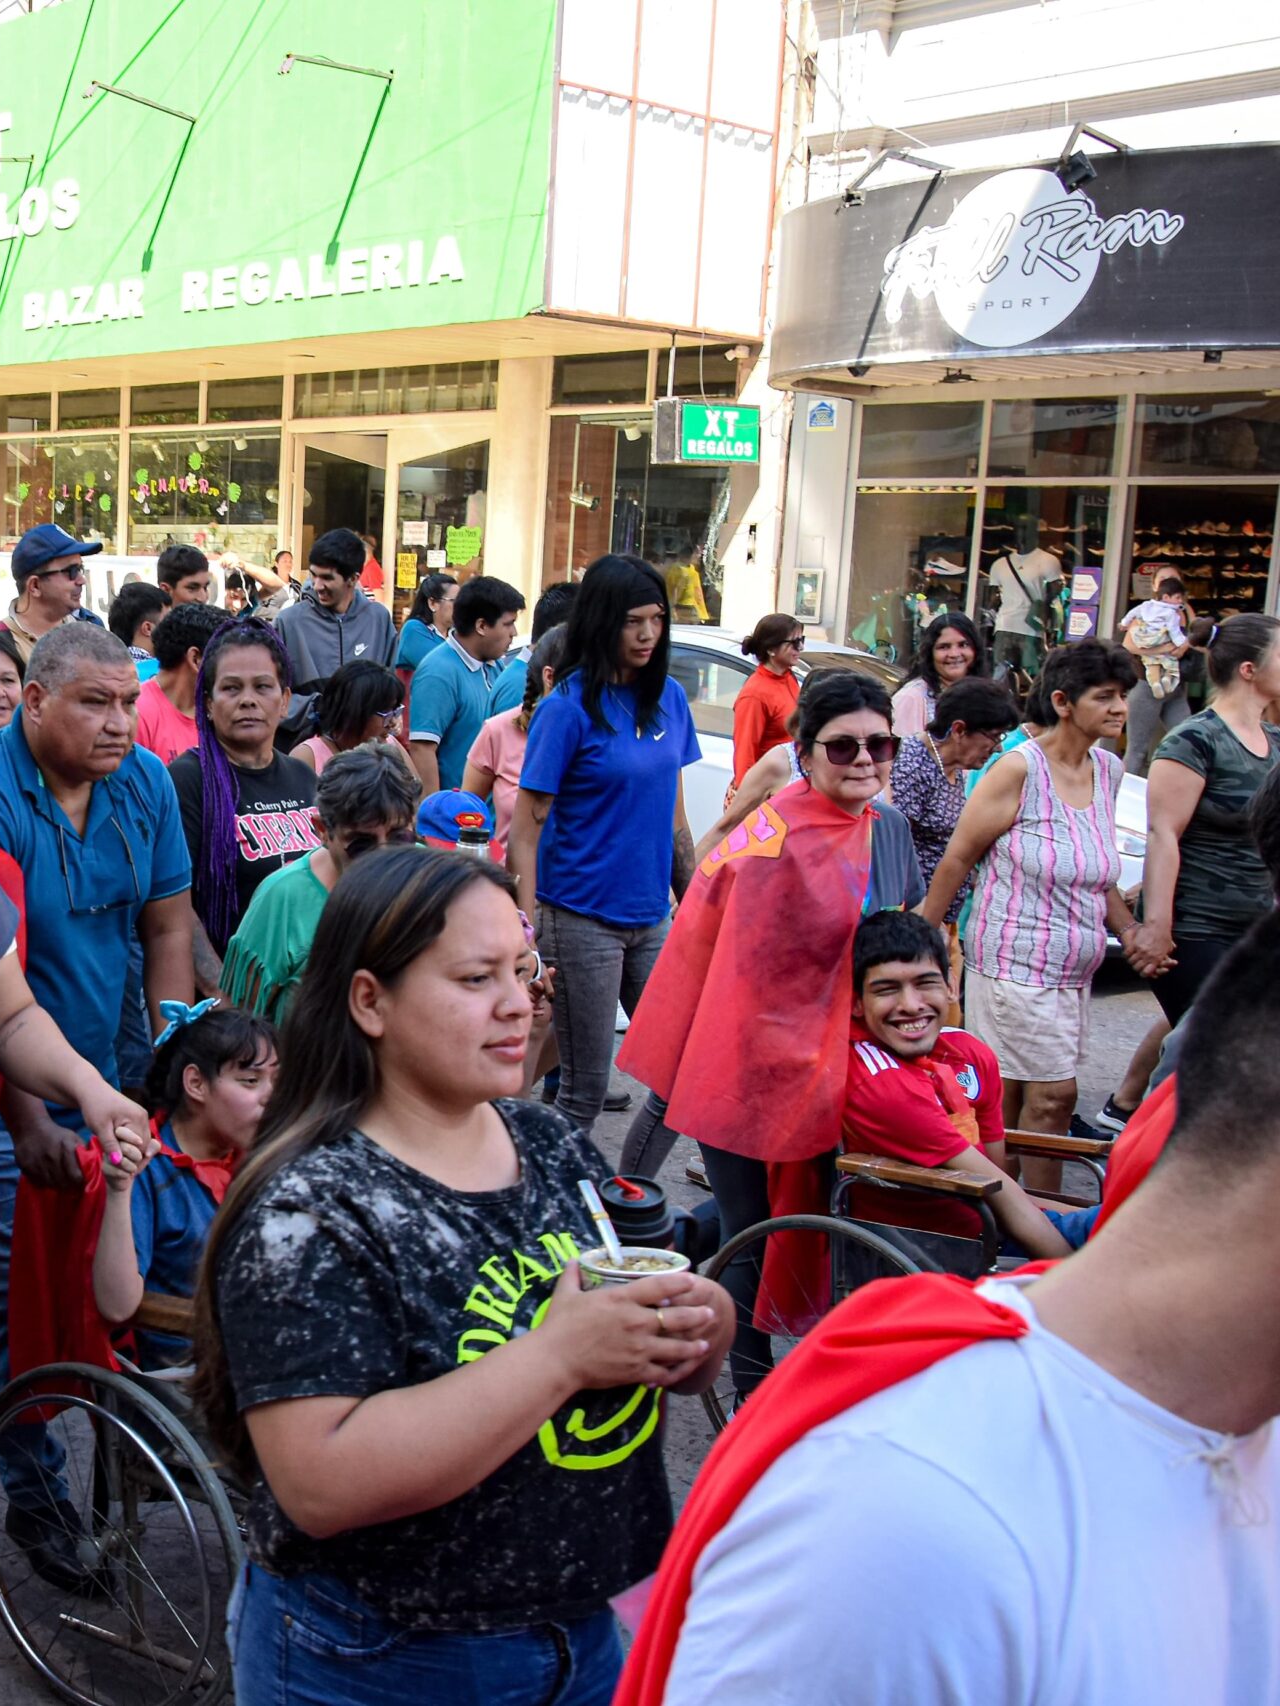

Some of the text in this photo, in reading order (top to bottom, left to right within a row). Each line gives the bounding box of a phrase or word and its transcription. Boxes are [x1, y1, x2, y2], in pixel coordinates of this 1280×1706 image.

[1021, 198, 1184, 282] Ram
[22, 278, 145, 331] BAZAR
[181, 235, 466, 313] REGALERIA
[968, 296, 1051, 311] SPORT
[704, 410, 740, 437] XT
[687, 439, 754, 457] REGALOS
[254, 799, 299, 812] Cherry Pain
